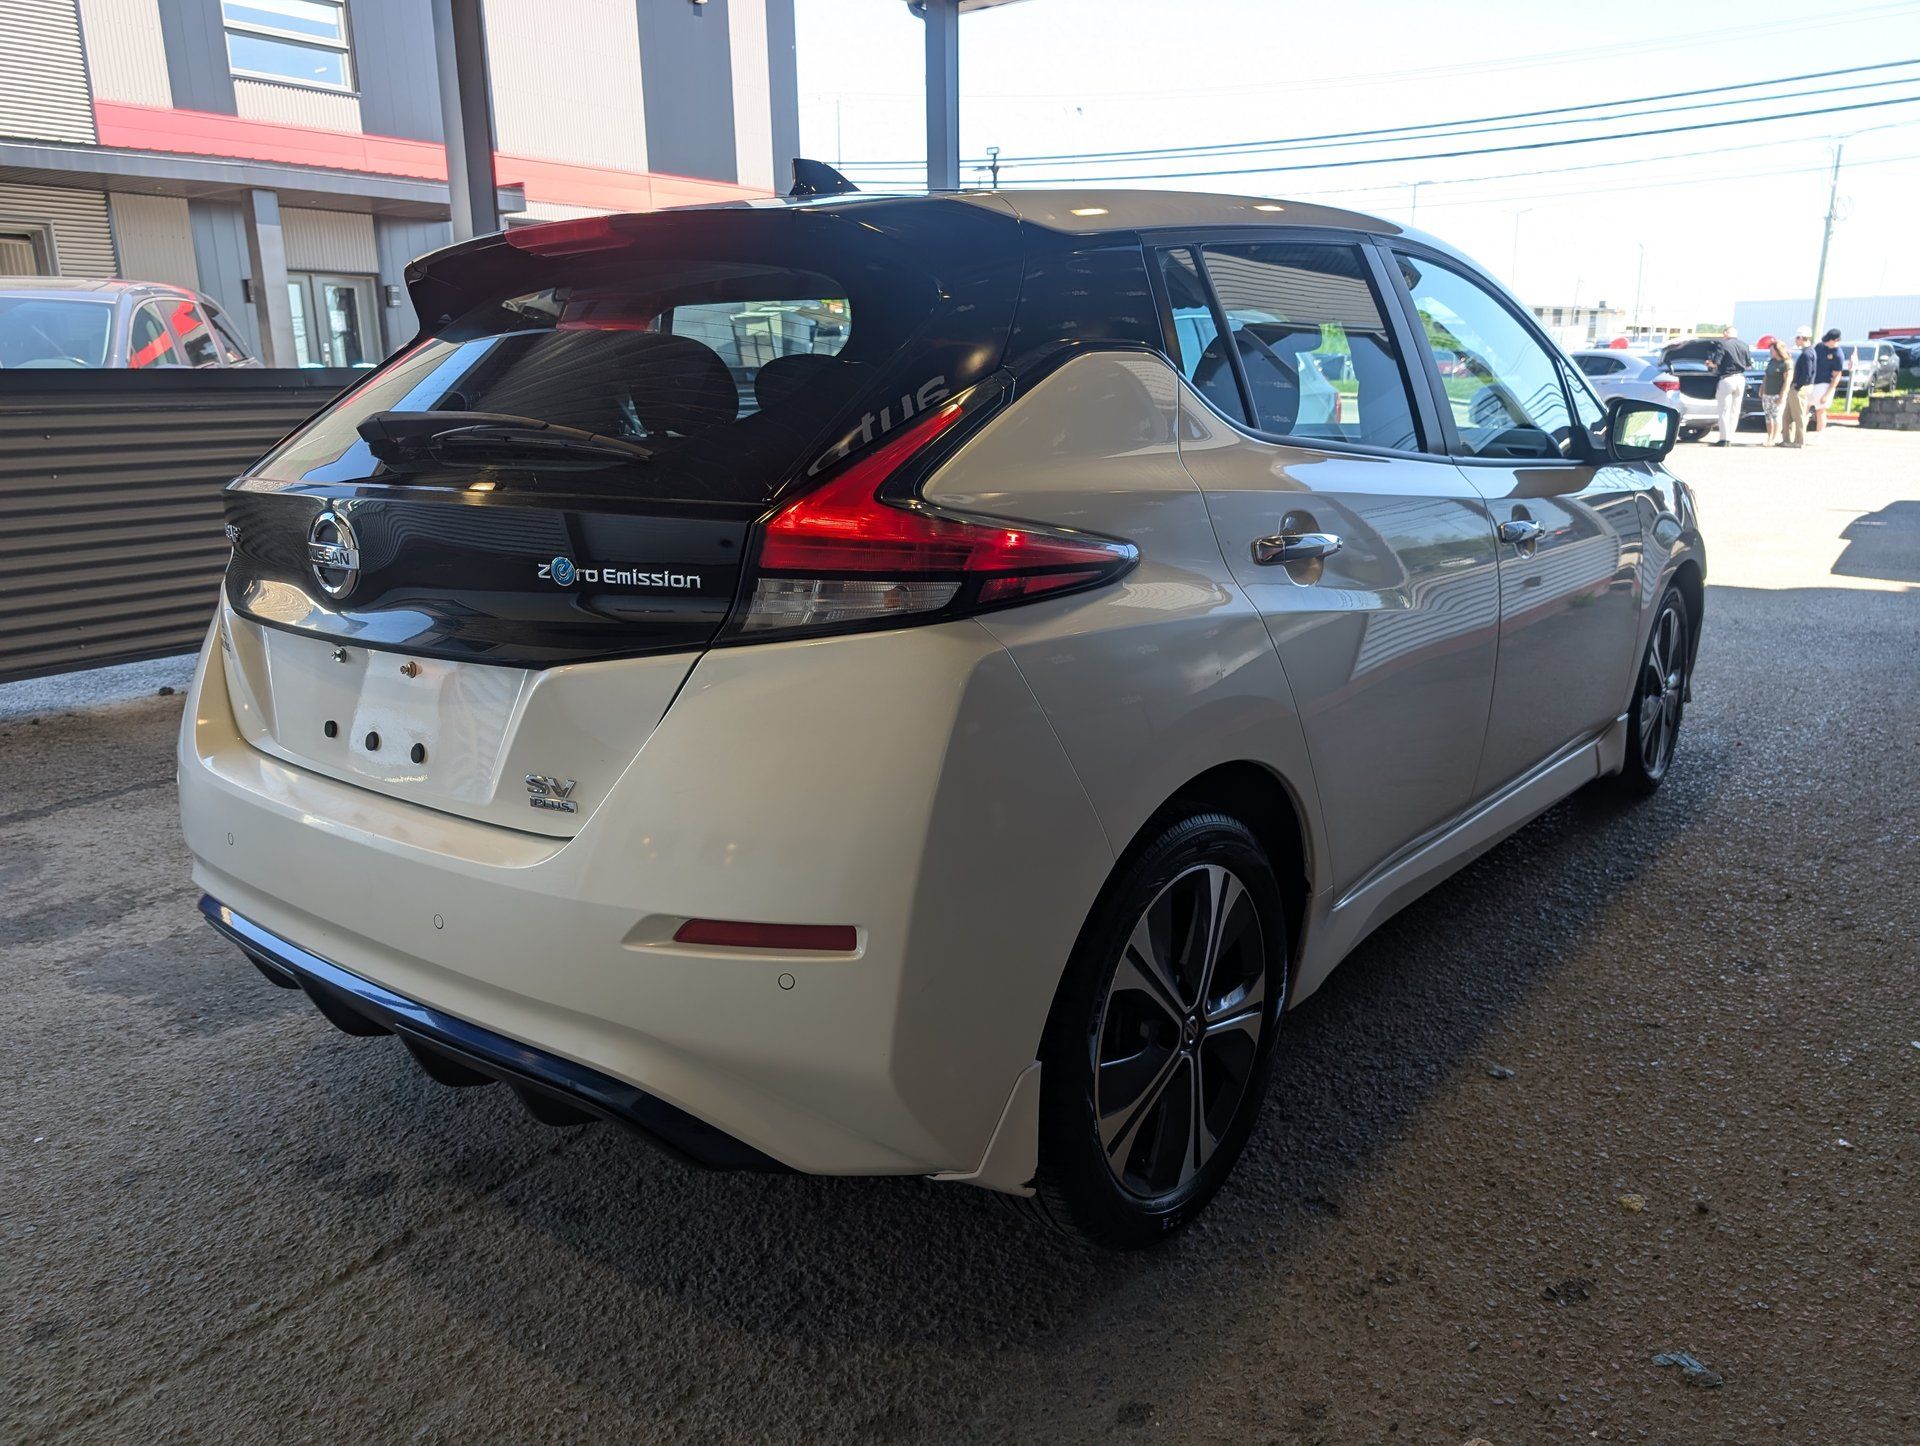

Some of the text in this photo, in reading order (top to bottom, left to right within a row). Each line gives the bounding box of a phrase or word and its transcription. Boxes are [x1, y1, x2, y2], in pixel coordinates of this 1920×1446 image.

[309, 548, 350, 566] NISSAN
[603, 568, 702, 588] Emission
[525, 774, 576, 799] SV
[533, 798, 572, 811] PLUS
